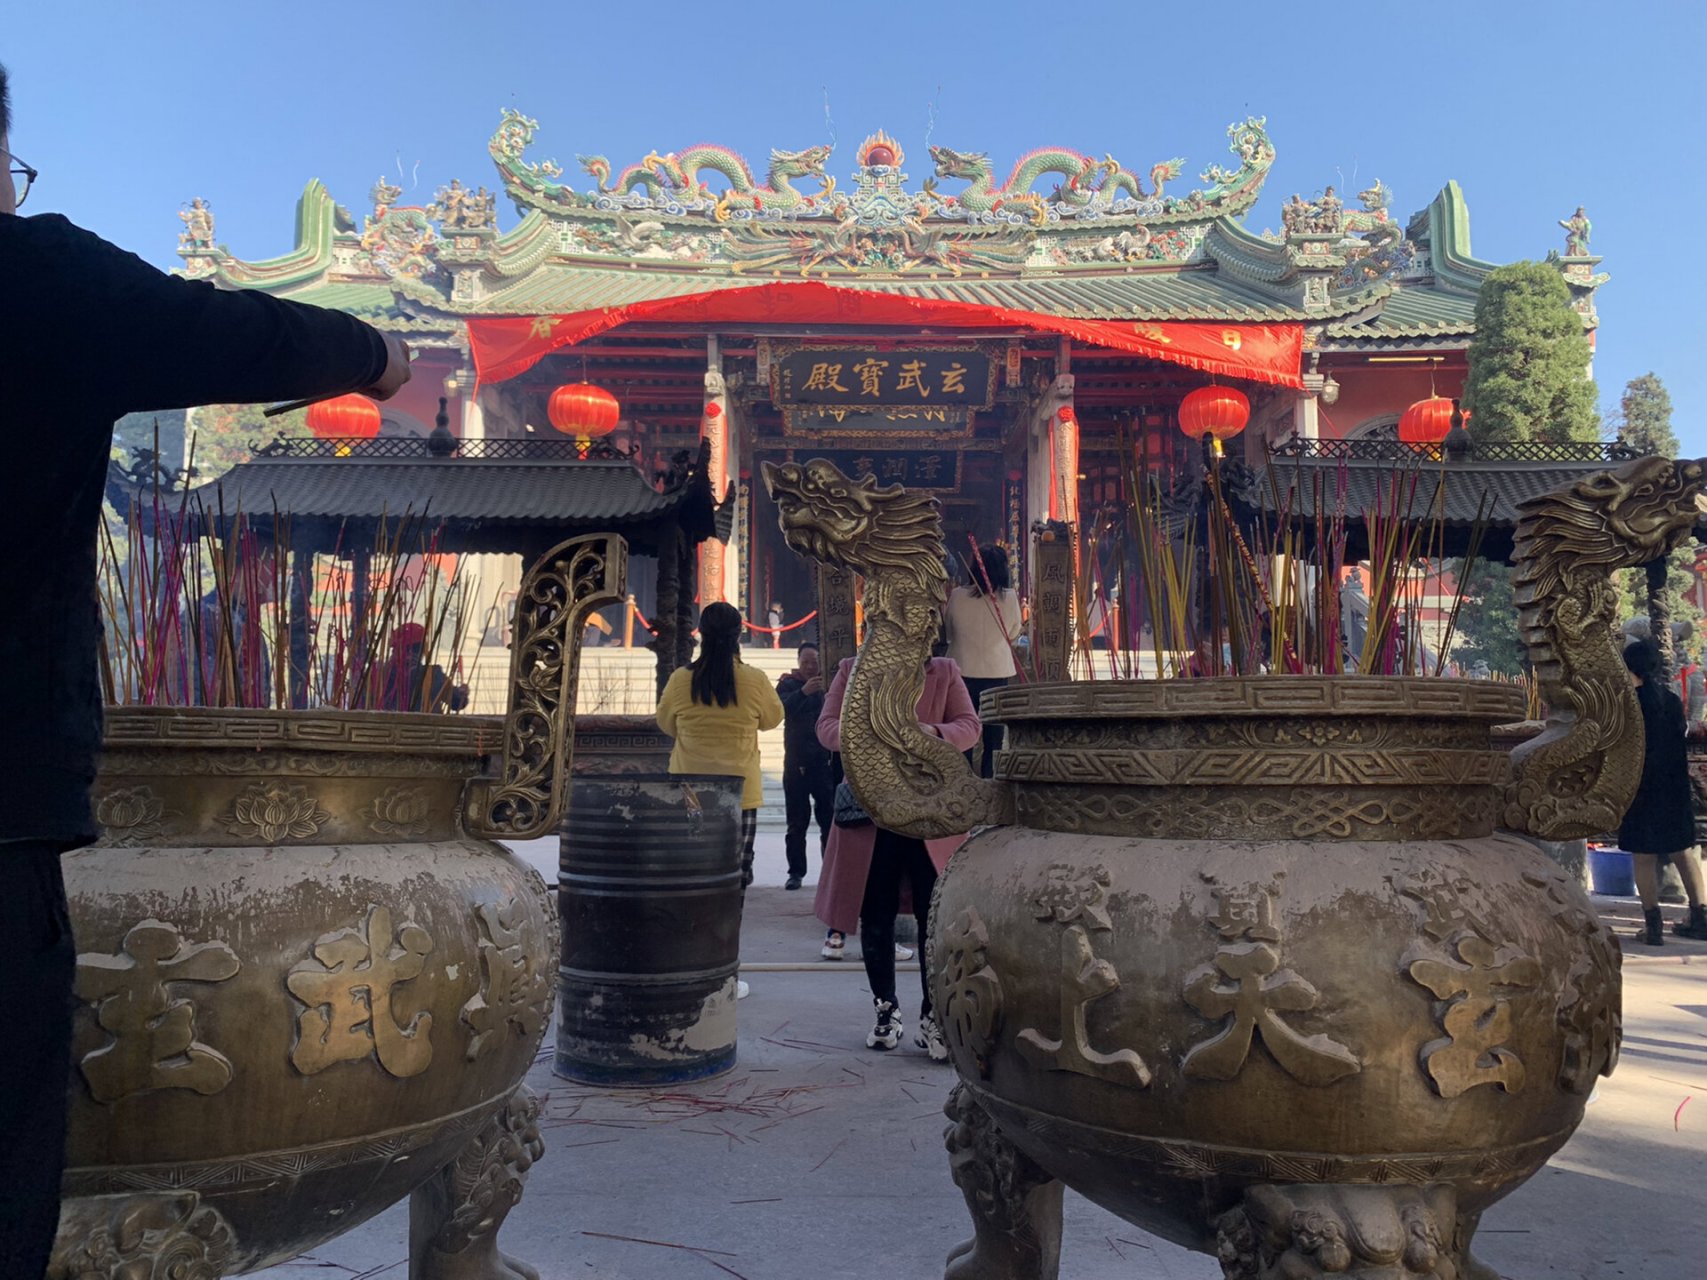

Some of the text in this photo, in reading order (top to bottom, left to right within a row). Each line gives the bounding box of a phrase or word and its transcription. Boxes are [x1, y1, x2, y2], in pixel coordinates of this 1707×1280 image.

[801, 357, 968, 397] 玄武寶殿
[828, 571, 849, 674] 合境平
